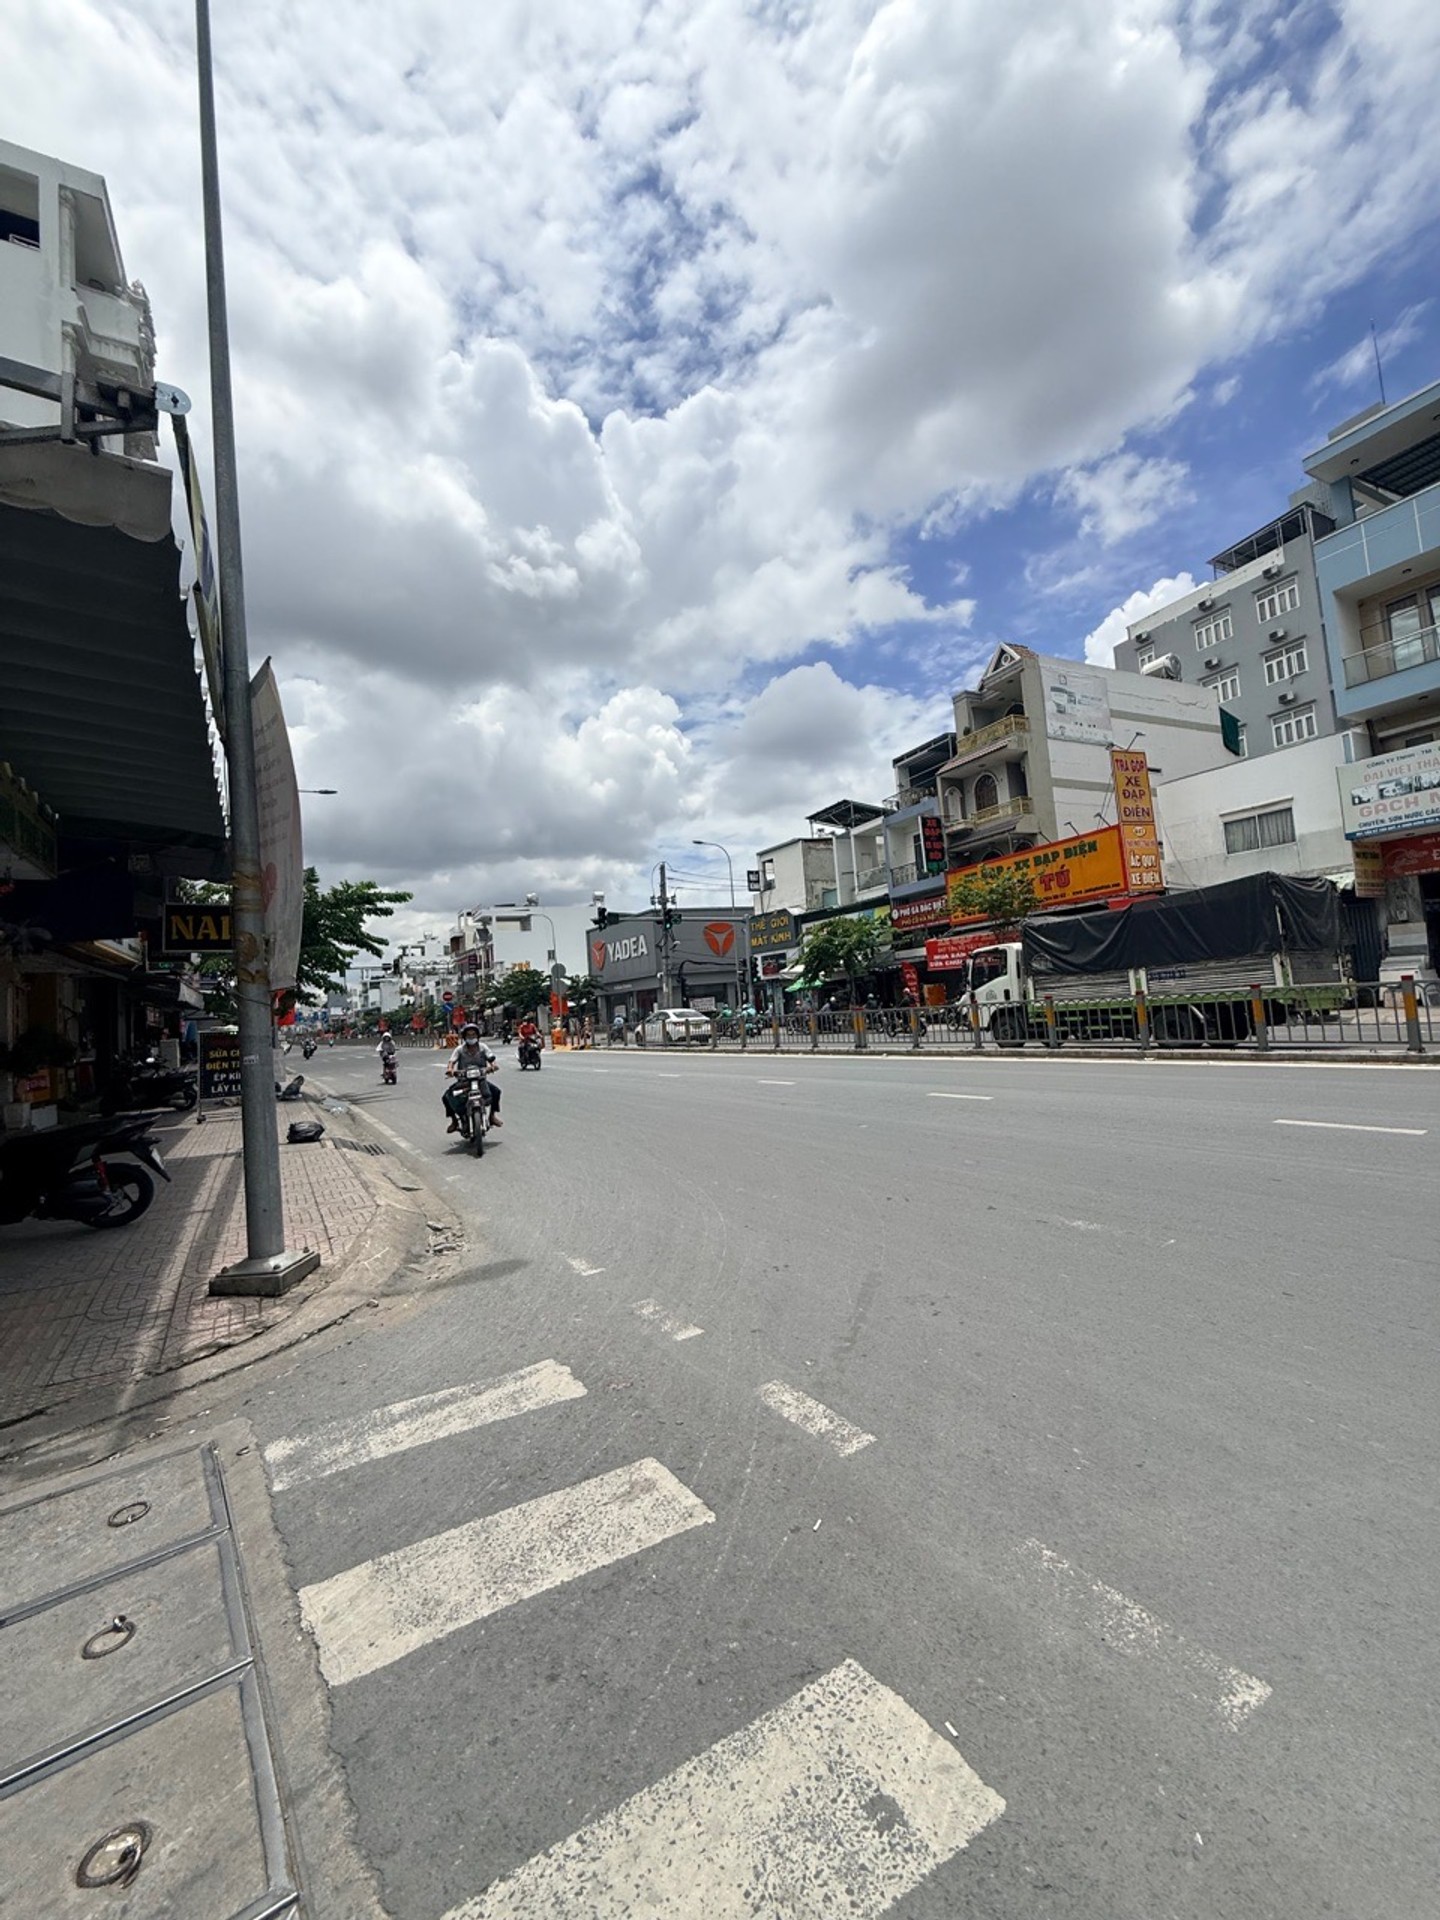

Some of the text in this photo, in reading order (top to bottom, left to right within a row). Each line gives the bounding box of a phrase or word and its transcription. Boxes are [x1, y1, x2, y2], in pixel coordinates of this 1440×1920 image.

[1125, 775, 1141, 787] XE
[1122, 788, 1146, 803] ĐẠP
[1064, 840, 1098, 859] ĐIỆN
[1040, 864, 1071, 892] TÚ
[607, 934, 648, 963] YADEA
[211, 1082, 229, 1093] LẤY
